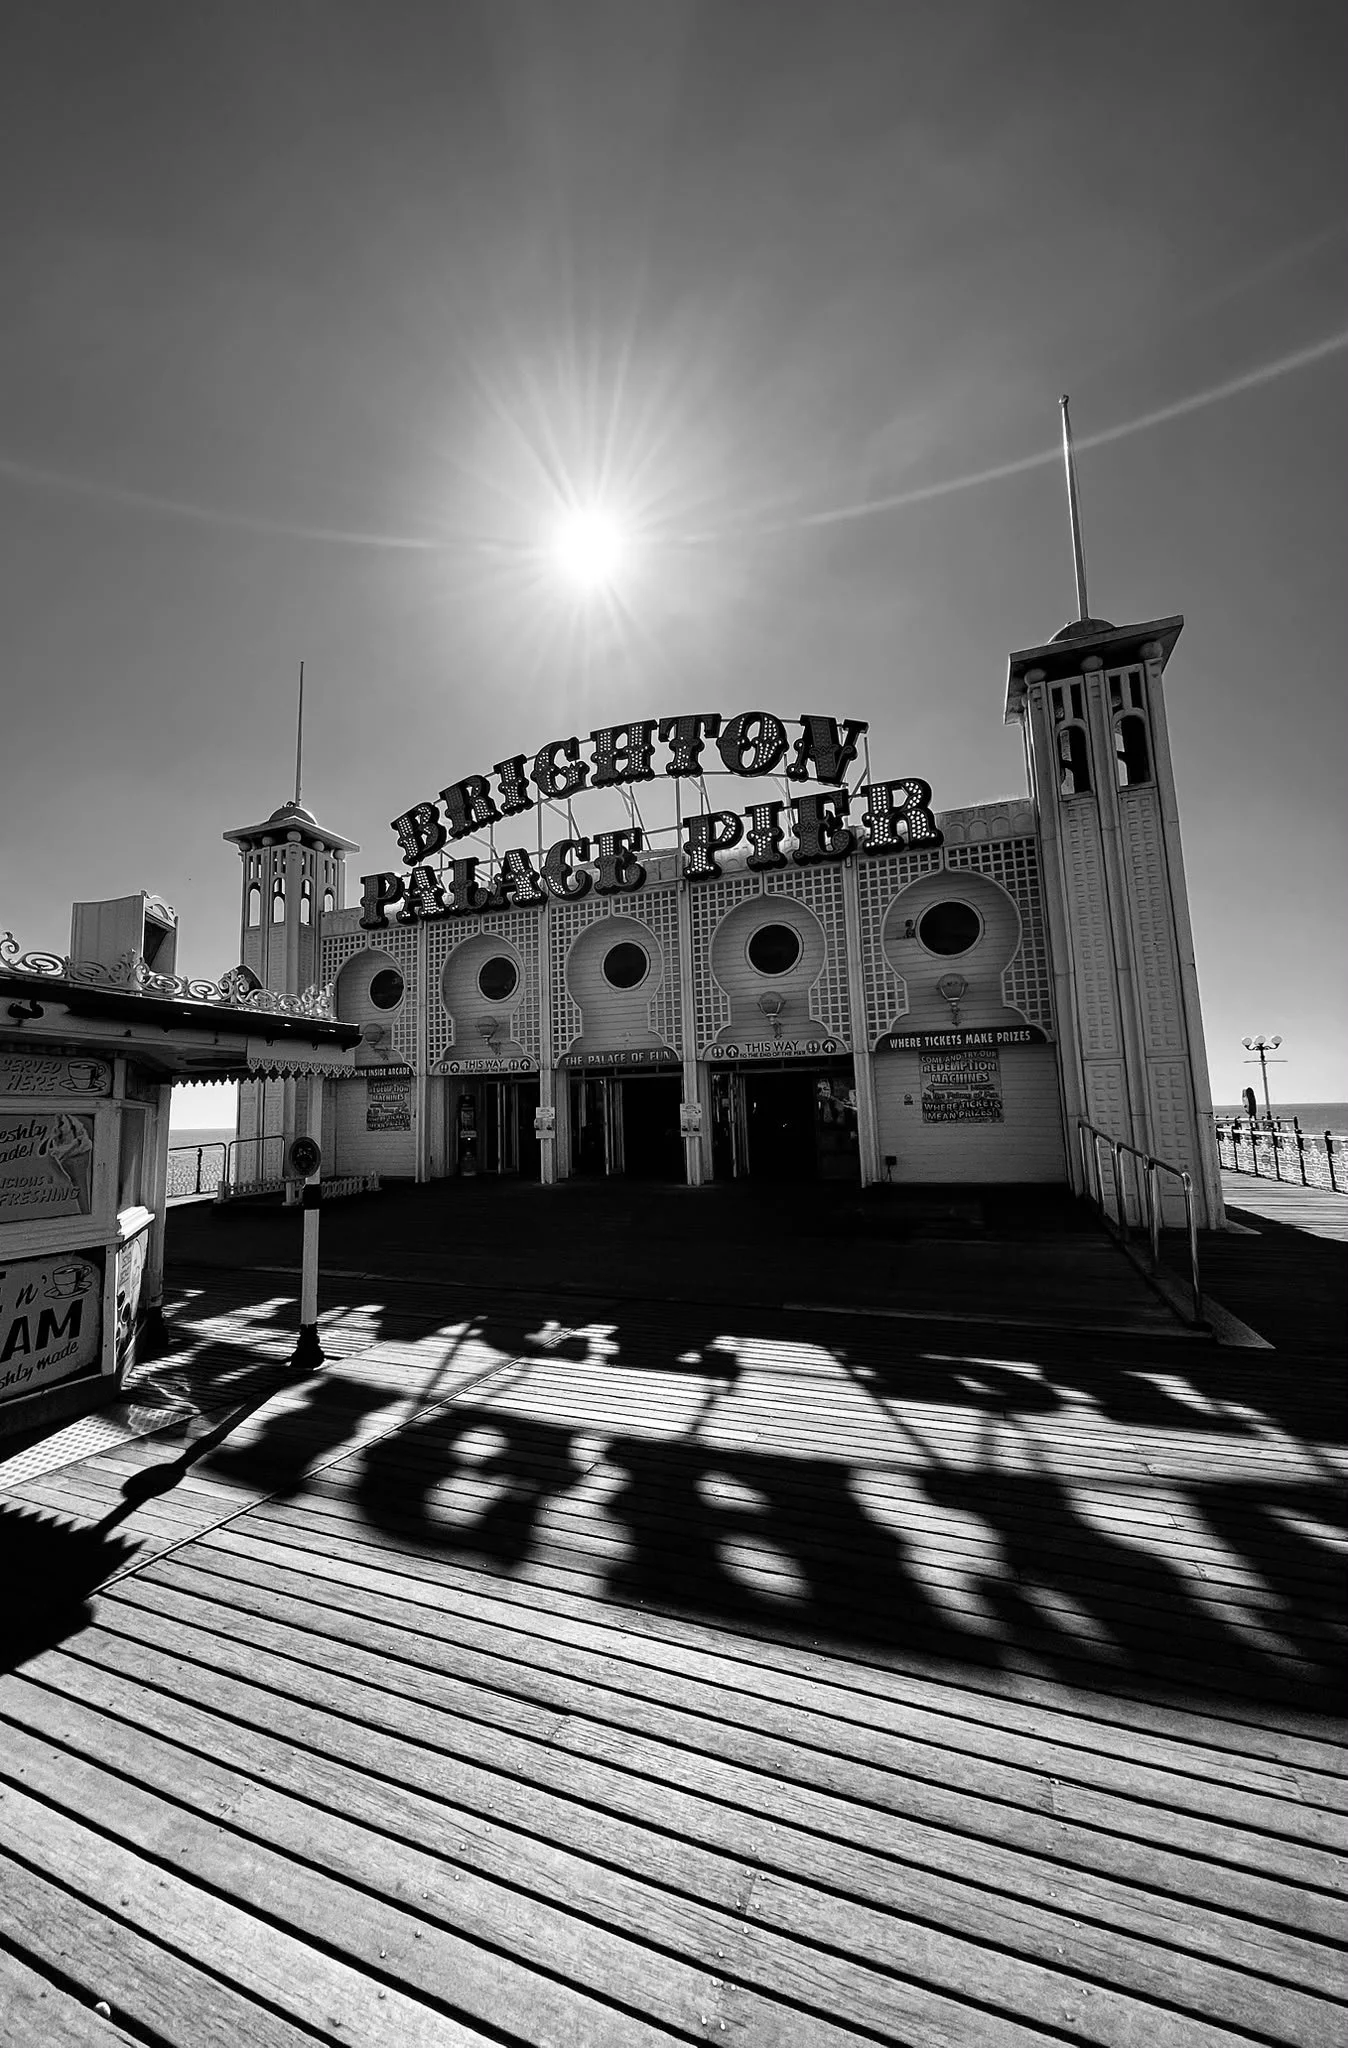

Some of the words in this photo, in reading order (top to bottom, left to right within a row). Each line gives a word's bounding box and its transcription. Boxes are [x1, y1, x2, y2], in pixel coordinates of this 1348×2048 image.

[391, 711, 869, 867] BRIGHTON
[359, 827, 647, 931] PALACE
[682, 777, 945, 882] PIER
[744, 1042, 771, 1052] THIS
[773, 1040, 799, 1051] WAY
[889, 1037, 922, 1049] WHERE
[925, 1035, 962, 1047] TICKETS
[965, 1033, 993, 1044] MAKE
[997, 1031, 1031, 1042] PRIZES
[464, 1060, 484, 1069] THIS
[485, 1059, 504, 1068] WAY
[564, 1056, 583, 1067] THE
[587, 1053, 626, 1065] PALACE
[631, 1052, 645, 1063] OF
[649, 1050, 671, 1062] FUN
[1, 1059, 62, 1074] SERVED
[387, 1066, 410, 1076] ARCADE
[922, 1060, 997, 1073] REDEMPTION
[6, 1075, 58, 1092] HERE
[931, 1072, 990, 1084] MACHINES
[923, 1102, 959, 1111] WHERE
[960, 1099, 1001, 1109] TICKETS
[37, 1341, 79, 1370] made
